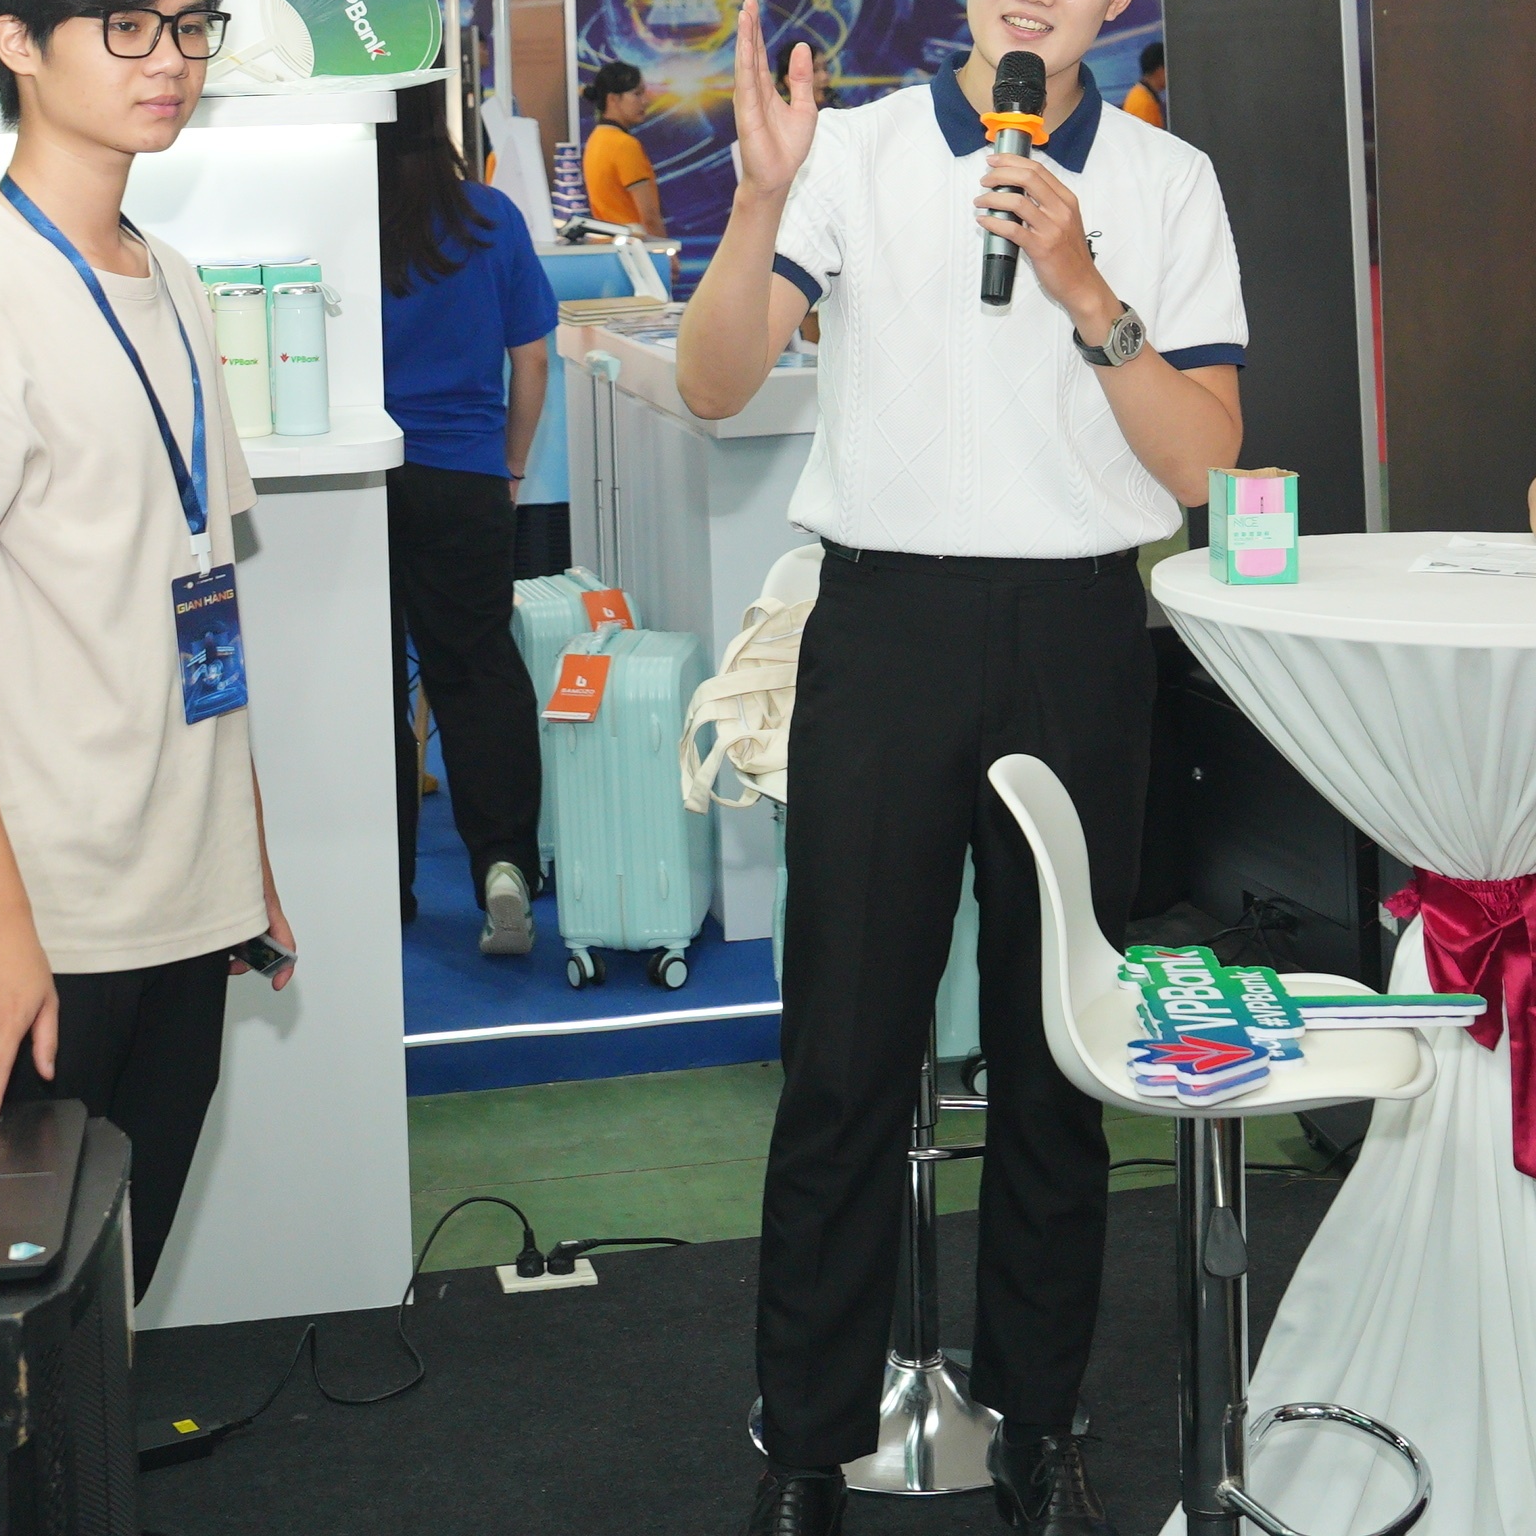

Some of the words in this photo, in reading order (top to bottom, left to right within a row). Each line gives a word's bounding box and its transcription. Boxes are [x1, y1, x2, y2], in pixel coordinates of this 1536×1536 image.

[176, 598, 203, 614] GIAN
[1141, 950, 1239, 1032] VPBank
[1229, 971, 1291, 1027] #VPBank
